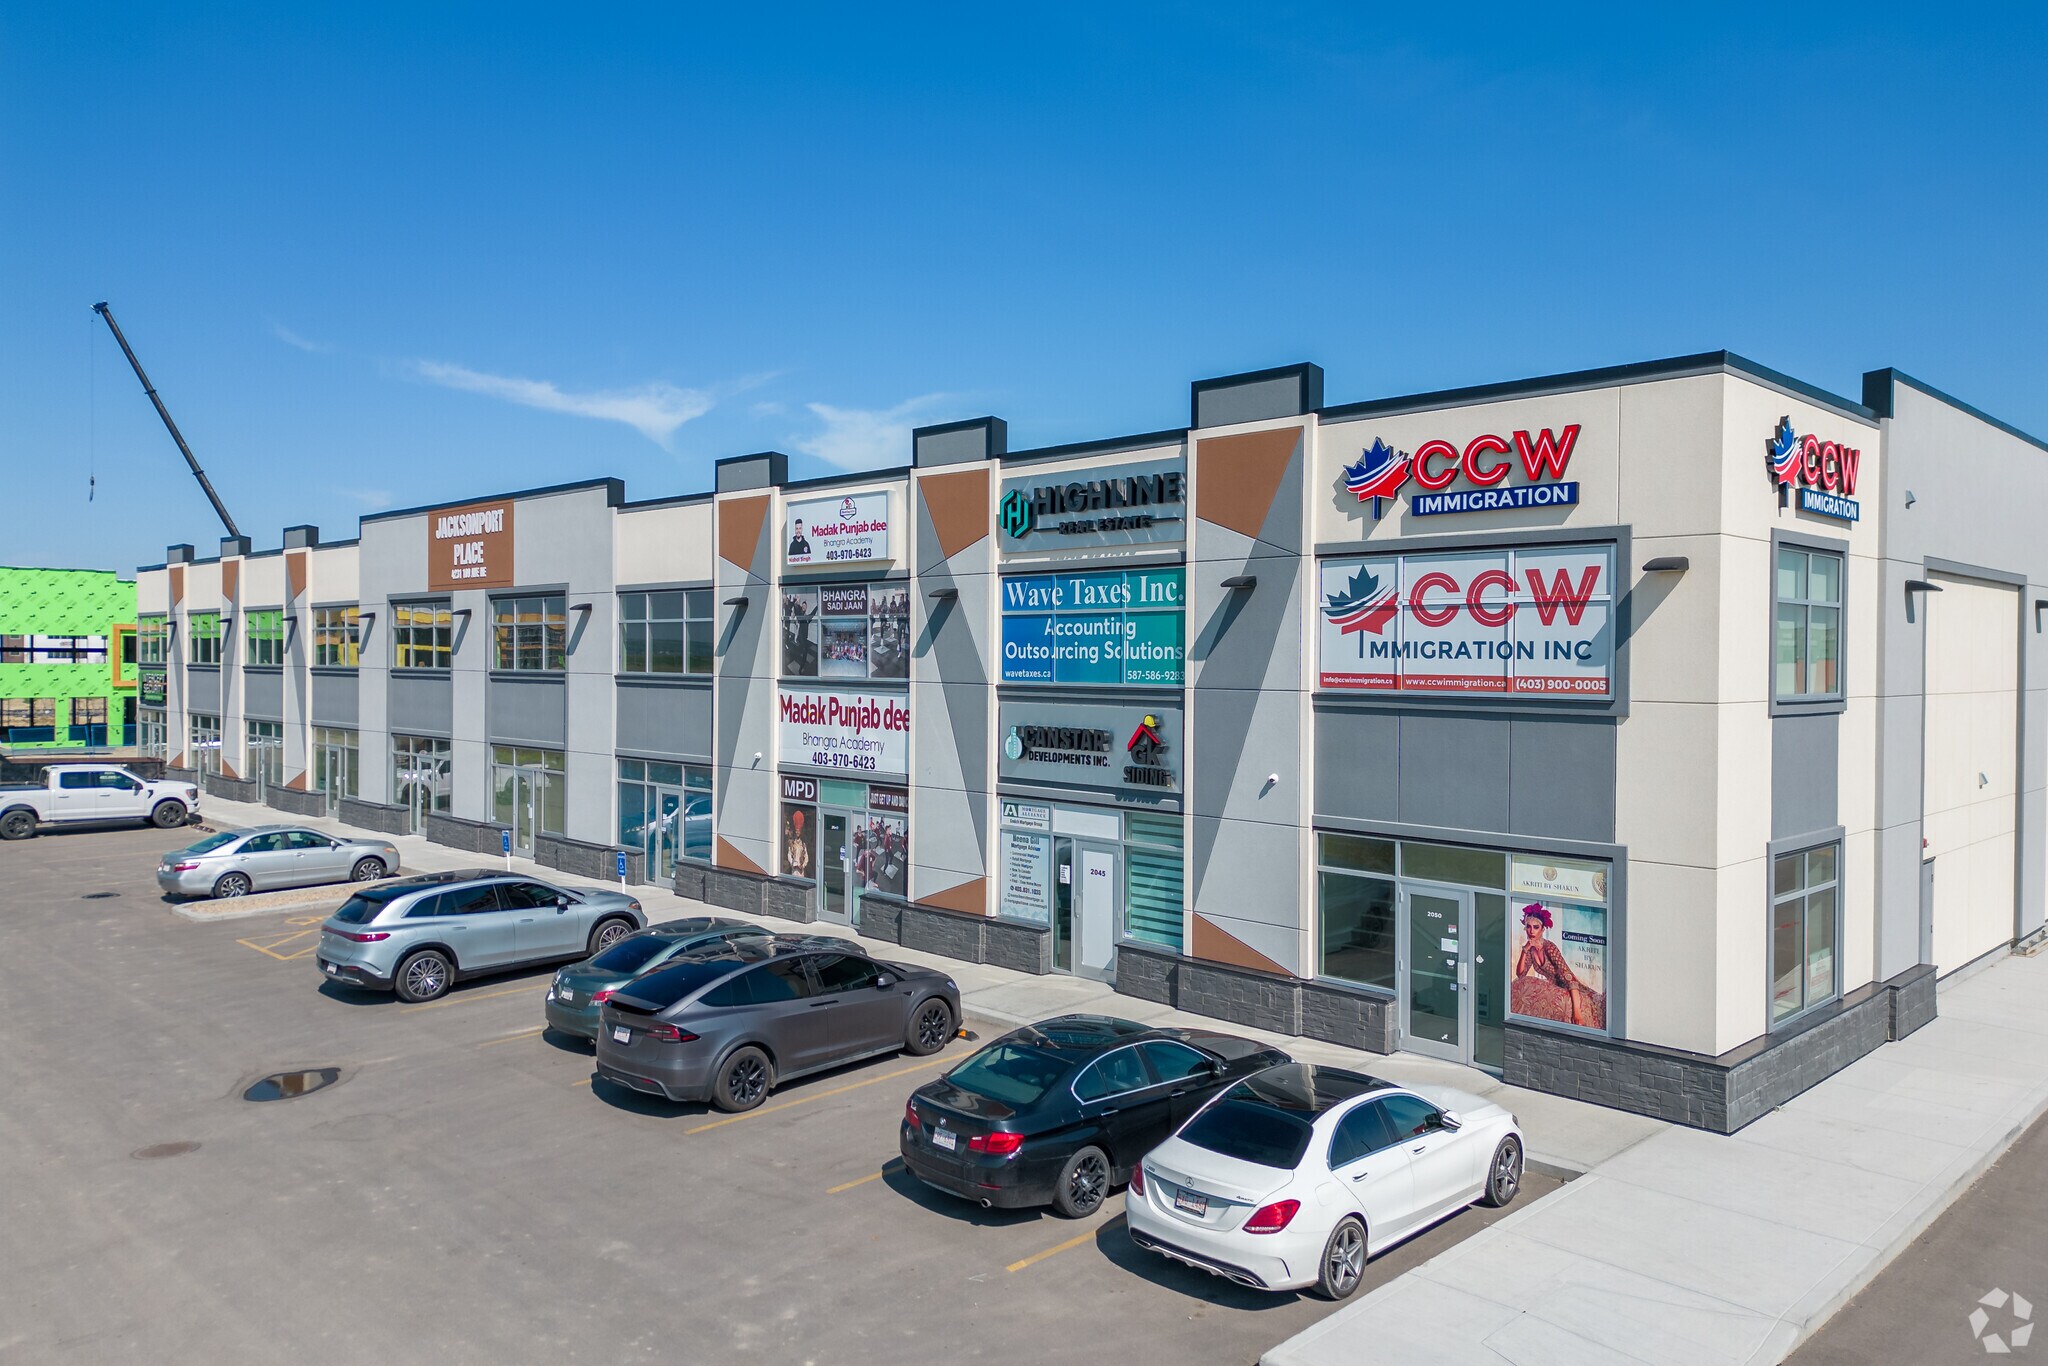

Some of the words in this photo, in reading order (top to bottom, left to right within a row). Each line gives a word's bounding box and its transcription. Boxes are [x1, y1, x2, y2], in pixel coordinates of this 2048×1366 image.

[1412, 424, 1581, 489] CCW
[1801, 434, 1860, 495] CCW
[1034, 472, 1184, 515] HIGHLINE
[1419, 485, 1570, 515] IMMIGRATION
[1804, 490, 1858, 520] IMMIGRATION
[435, 508, 504, 539] JACKSONPORT
[811, 524, 838, 538] Madak
[839, 521, 870, 538] Punjab
[870, 519, 887, 532] dee
[1059, 520, 1097, 534] REAL
[1097, 515, 1152, 532] ESTATE
[823, 538, 845, 548] Bhangra
[846, 536, 873, 547] Academy
[453, 541, 484, 566] PLACE
[826, 548, 872, 561] 403-970-6423
[822, 590, 866, 602] BHANGRA
[1006, 579, 1064, 607] Wave
[1069, 576, 1131, 605] Taxes
[1139, 575, 1184, 602] Inc.
[1409, 565, 1601, 628] CCW
[827, 602, 844, 611] SADI
[844, 601, 863, 610] JAAN
[1045, 616, 1136, 639] Accounting
[1005, 641, 1099, 663] Outsourcing
[1104, 640, 1184, 660] Solutions
[1544, 640, 1593, 660] INC
[1005, 669, 1051, 678] wavetaxes.ca
[1323, 676, 1393, 685] info@ccwimmigration.ca
[1405, 677, 1507, 689] www.ccwimmigration.ca
[1515, 678, 1545, 691] (403)
[1547, 679, 1607, 691] 900-0005
[780, 694, 826, 725] Madak
[829, 696, 881, 735] Punjab
[884, 699, 910, 732] dee
[802, 732, 838, 751] Bhangra
[839, 736, 885, 755] Academy
[1024, 725, 1109, 752] CANSTAR
[812, 751, 876, 770] 403-970-6423
[1028, 750, 1091, 765] DEVELOPMENTS
[1093, 755, 1110, 767] INC.
[1131, 738, 1164, 766] GK
[1123, 766, 1171, 787] SIDING
[784, 779, 815, 799] MPD
[1090, 868, 1106, 877] 2045
[1521, 880, 1542, 888] AKRITI
[1553, 884, 1580, 892] SHAKUN
[1427, 911, 1442, 919] 2050
[1562, 931, 1588, 943] Coming
[1588, 935, 1606, 945] Soon
